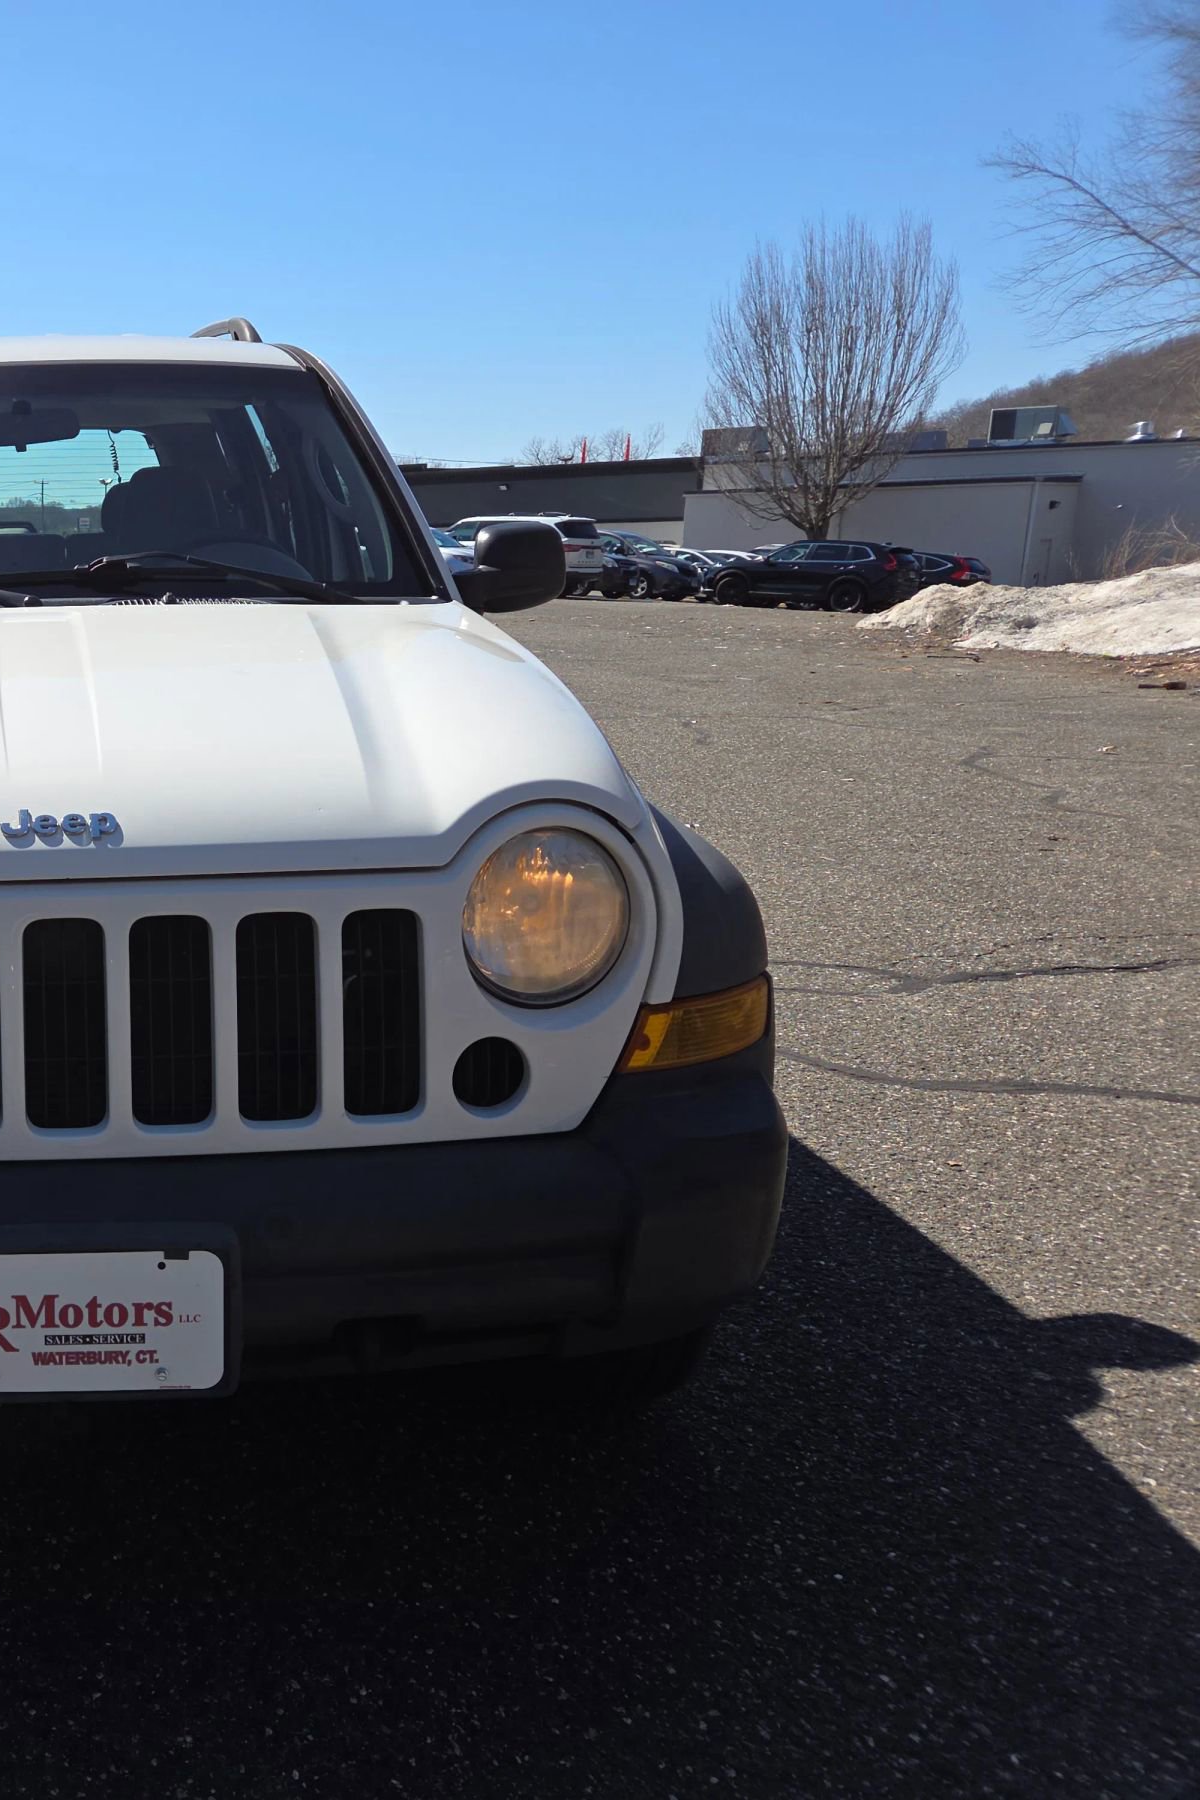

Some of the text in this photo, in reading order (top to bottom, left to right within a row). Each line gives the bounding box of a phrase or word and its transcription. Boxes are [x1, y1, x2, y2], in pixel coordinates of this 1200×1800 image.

[0, 809, 118, 840] Jeep
[11, 1294, 174, 1329] Motors
[179, 1313, 201, 1323] LLC
[46, 1333, 144, 1345] SALES SERVICE
[31, 1349, 160, 1367] WATERBURY, CT.
